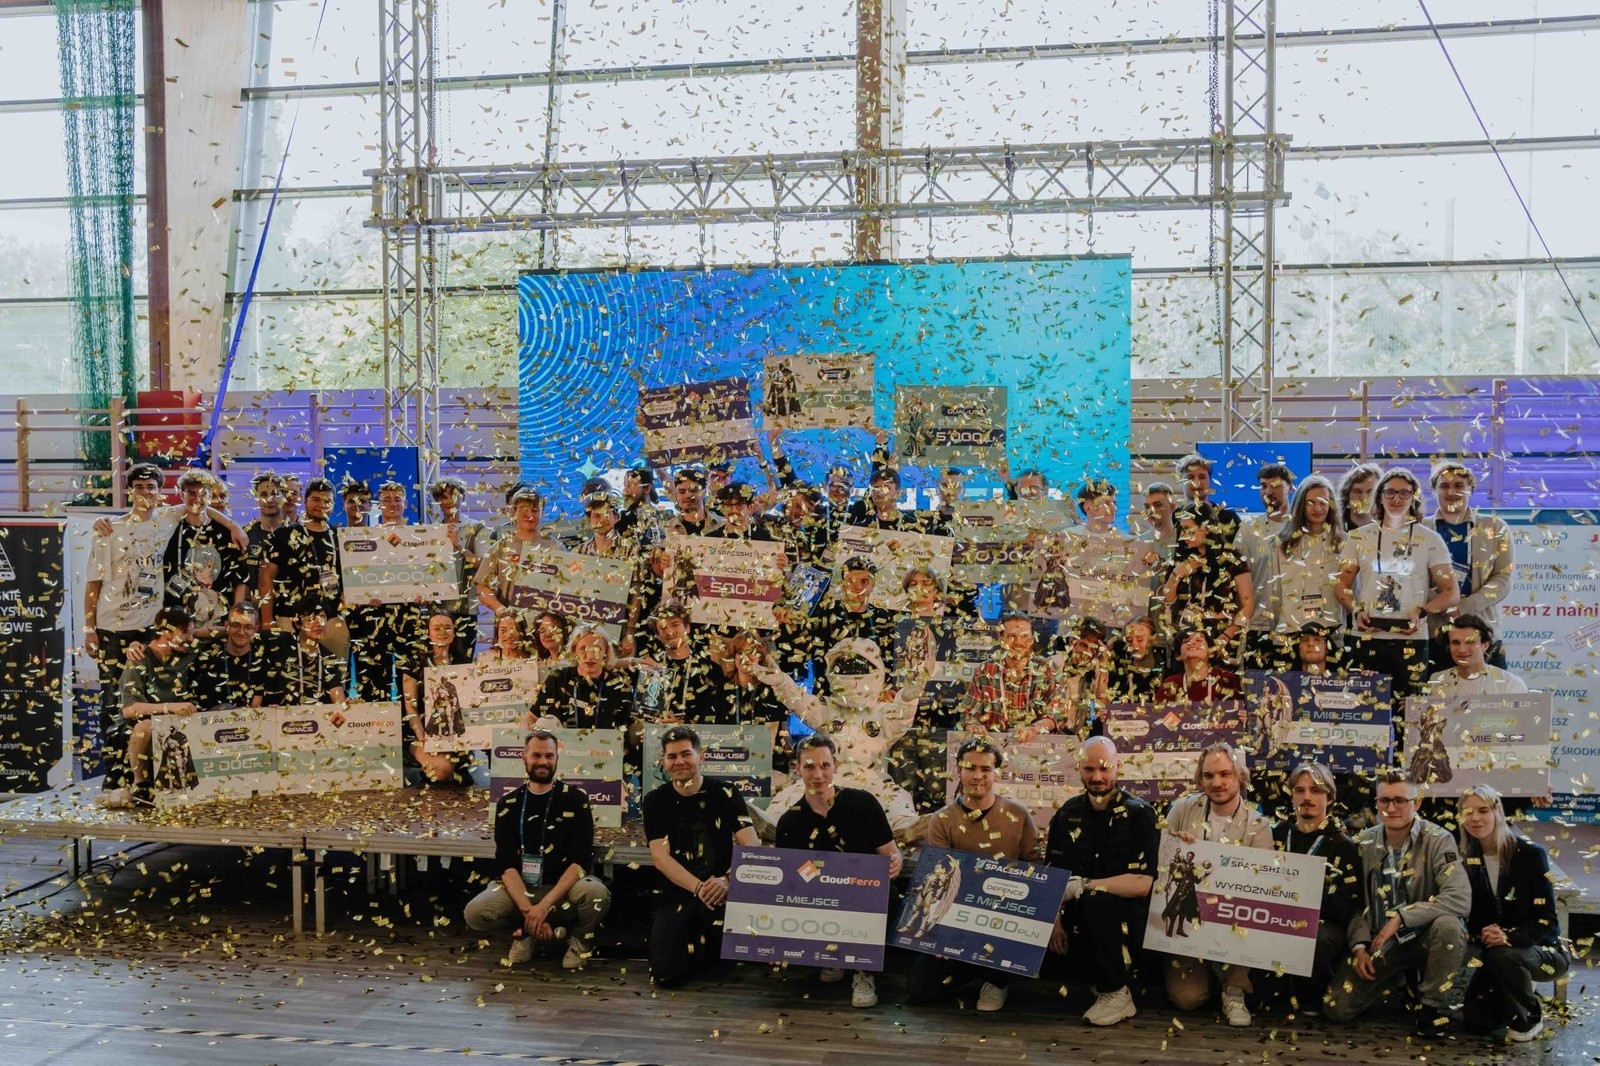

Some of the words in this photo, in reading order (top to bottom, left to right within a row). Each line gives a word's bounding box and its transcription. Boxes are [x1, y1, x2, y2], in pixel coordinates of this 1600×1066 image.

[1542, 606, 1552, 617] z
[469, 711, 480, 721] 5
[203, 762, 214, 773] 2
[740, 873, 778, 882] DEFENCE
[819, 875, 881, 887] CloudFerro
[986, 884, 1025, 897] DEFENCE
[776, 894, 785, 903] 2
[786, 895, 839, 907] MIEJSCE
[964, 893, 975, 903] 2
[976, 896, 1037, 915] MIEJSCE
[1217, 902, 1270, 924] 500
[1270, 916, 1297, 929] PLN
[781, 918, 841, 936] 000
[841, 930, 867, 939] PLN
[955, 911, 970, 923] 5
[974, 914, 1019, 933] 000
[1017, 928, 1040, 938] PLN
